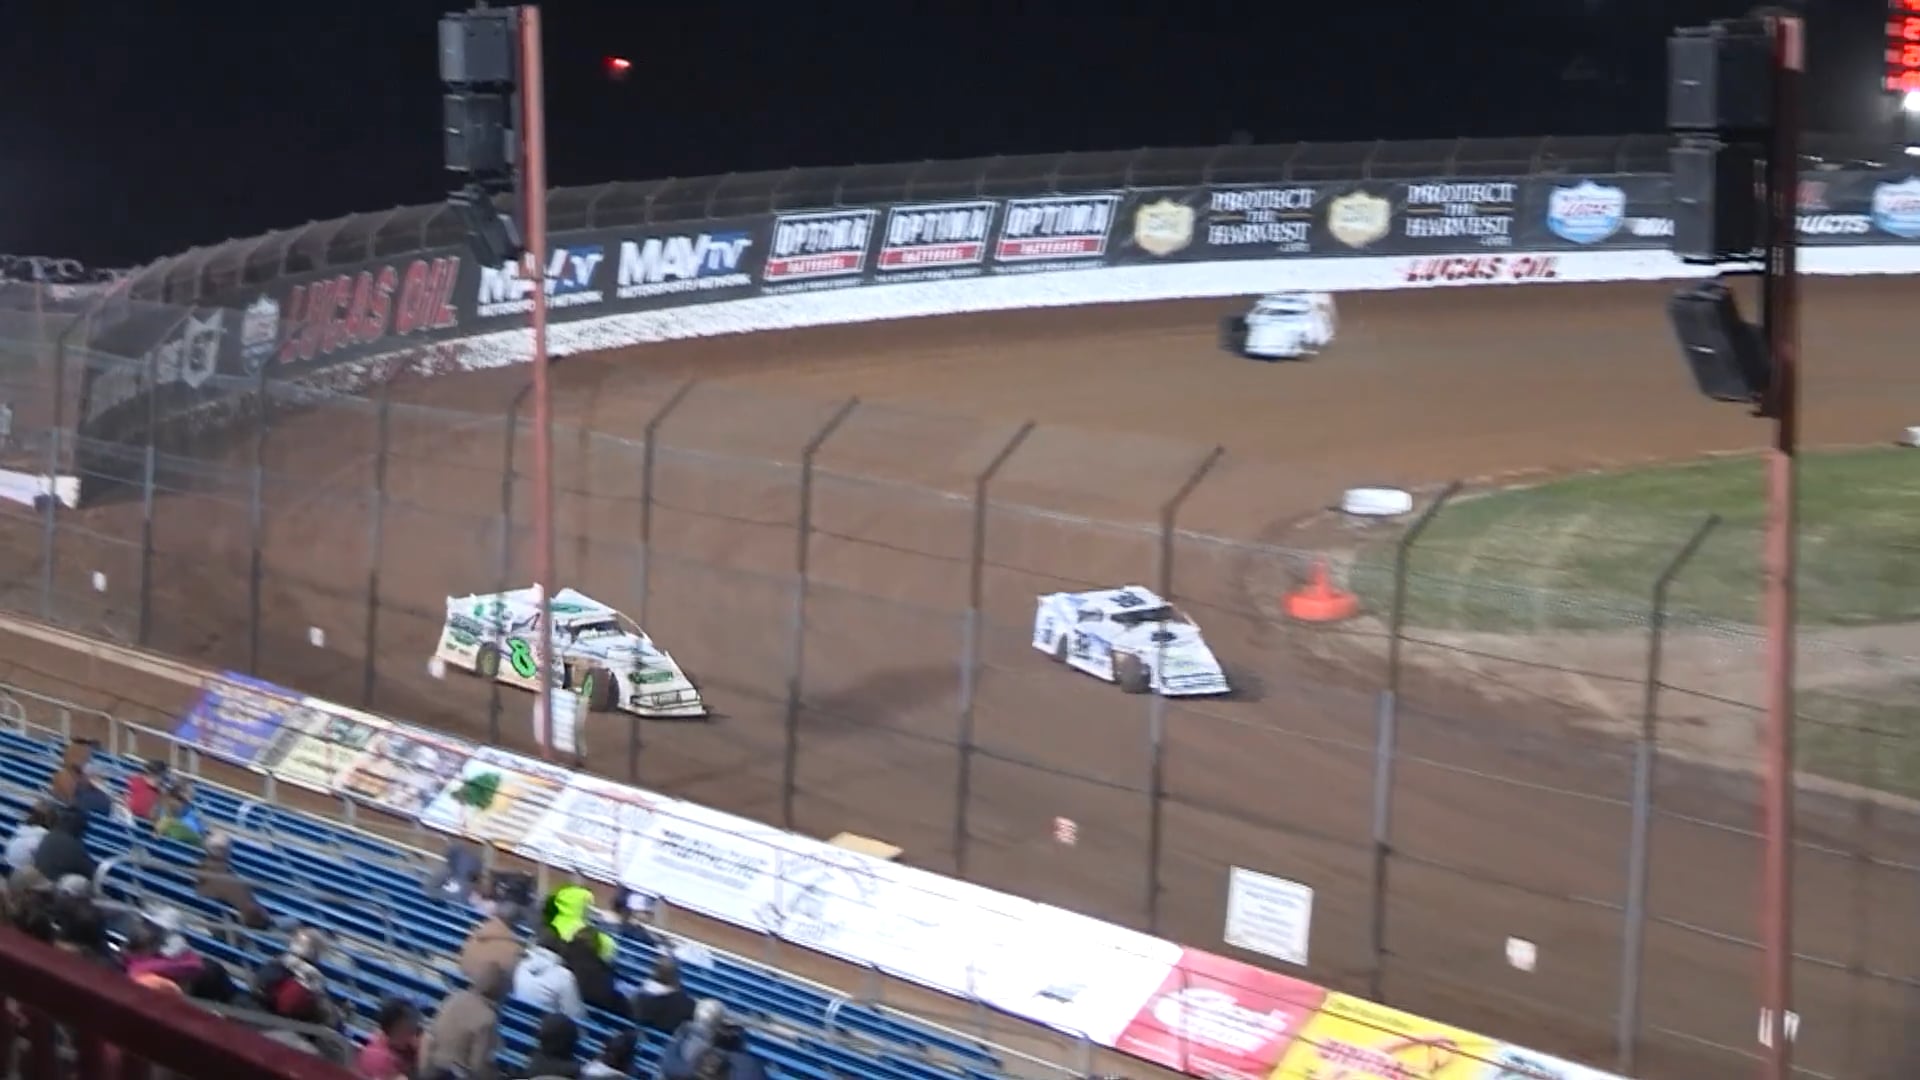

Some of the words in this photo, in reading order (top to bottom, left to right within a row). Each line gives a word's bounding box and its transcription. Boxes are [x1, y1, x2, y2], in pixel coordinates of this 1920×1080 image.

[775, 217, 867, 256] OPTIMA
[890, 209, 986, 245] OPTIMA
[1007, 202, 1108, 236] OPTIMA
[1406, 255, 1505, 281] LUCAS
[1510, 256, 1558, 280] OIL
[278, 264, 398, 364] LUCAS
[396, 255, 461, 336] OIL
